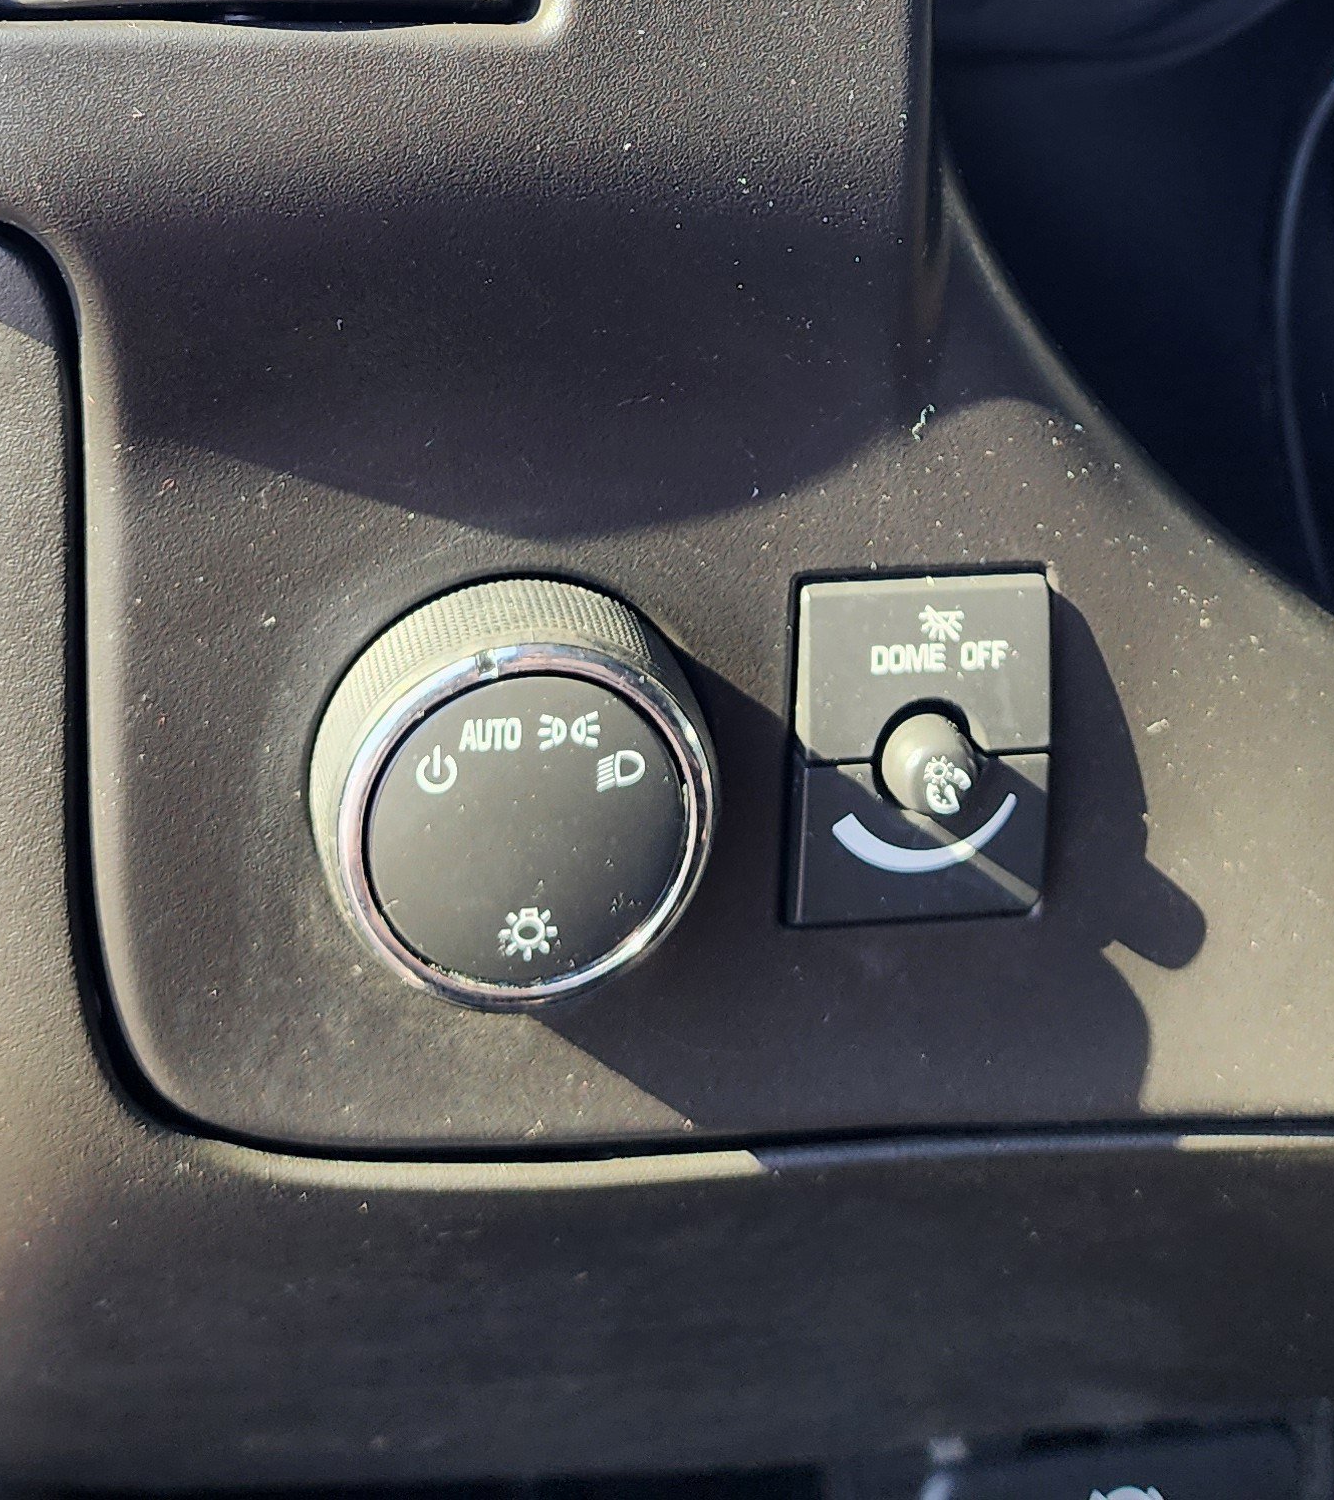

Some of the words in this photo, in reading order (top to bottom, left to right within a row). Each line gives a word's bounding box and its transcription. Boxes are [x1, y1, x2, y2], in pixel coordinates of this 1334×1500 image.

[870, 643, 946, 675] DOME
[960, 640, 1009, 671] OFF
[458, 717, 522, 752] AUTO
